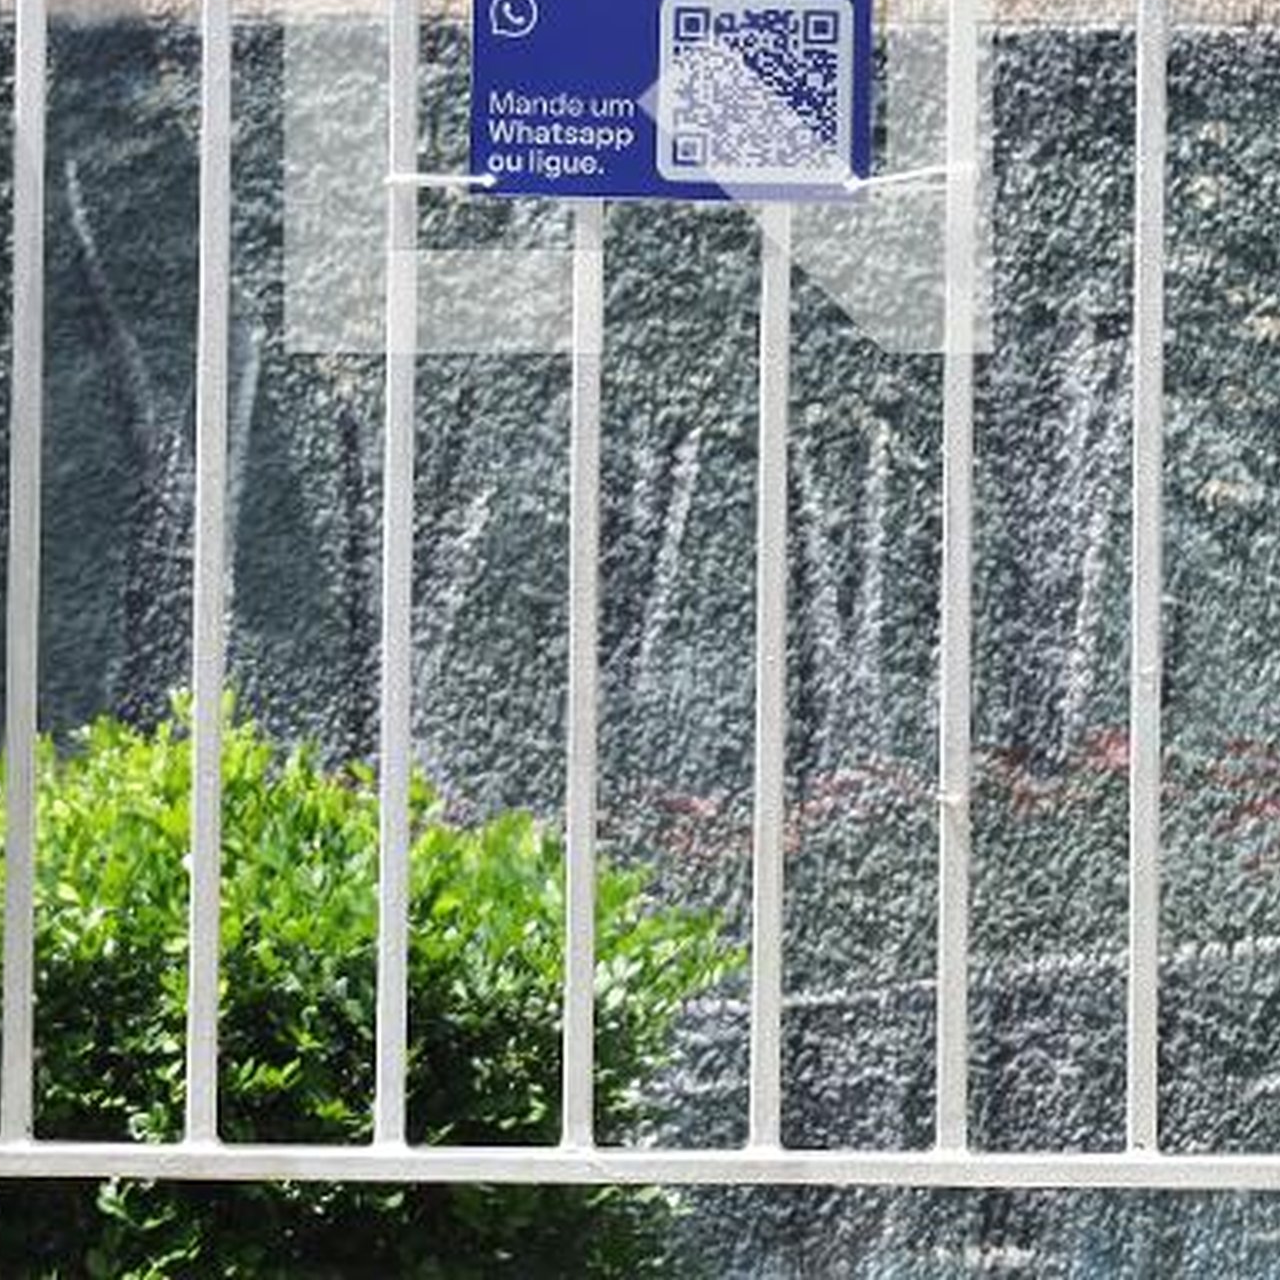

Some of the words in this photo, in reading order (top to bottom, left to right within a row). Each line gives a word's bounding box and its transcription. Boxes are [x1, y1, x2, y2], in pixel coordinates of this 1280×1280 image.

[489, 91, 583, 117] Mande
[591, 97, 635, 117] um
[488, 120, 635, 151] Whatsapp
[488, 153, 521, 172] ou
[529, 149, 605, 178] ligue.
